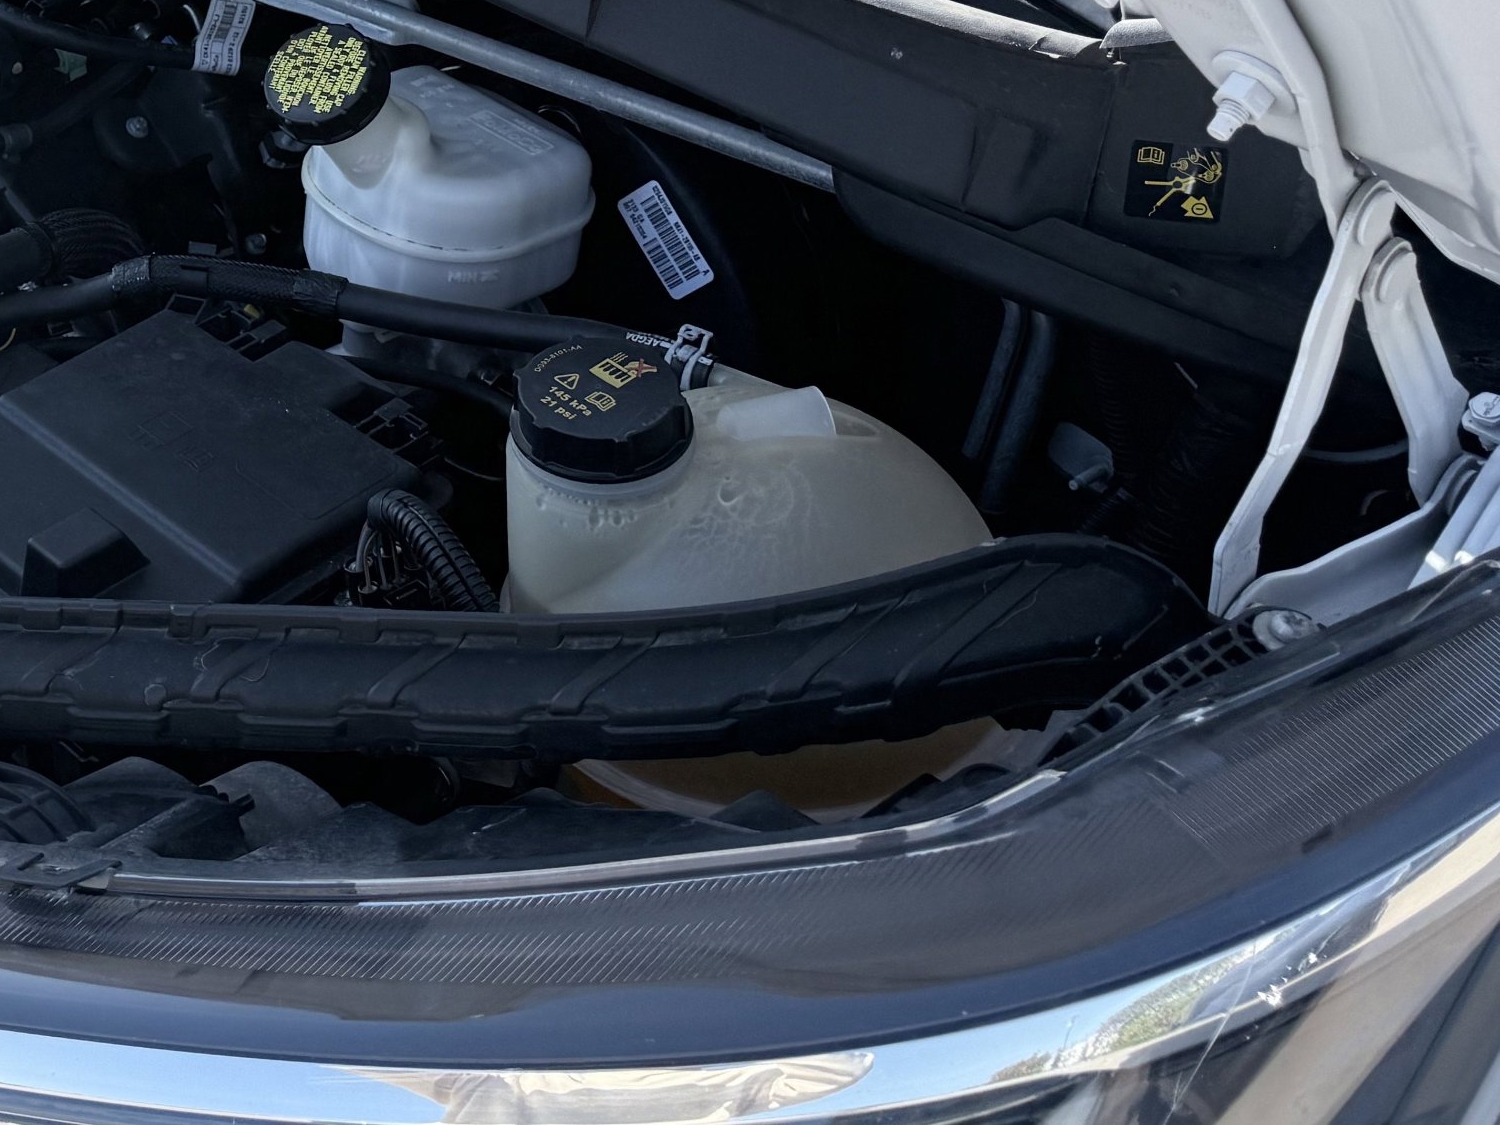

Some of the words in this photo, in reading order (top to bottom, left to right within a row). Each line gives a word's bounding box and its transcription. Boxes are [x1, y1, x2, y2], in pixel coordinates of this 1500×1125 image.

[341, 36, 356, 52] ONLY
[344, 40, 363, 63] BEFORE
[325, 46, 342, 69] SEALED
[334, 53, 347, 66] DOT
[350, 49, 367, 69] CLEAN
[306, 65, 316, 74] LE
[321, 74, 337, 93] FLUID
[339, 70, 356, 91] FILLER
[312, 94, 328, 113] FROM
[320, 99, 334, 113] USE
[332, 93, 346, 106] CAP
[540, 396, 556, 410] 21
[554, 406, 577, 421] psi
[548, 386, 572, 402] 145
[569, 399, 592, 417] kPa
